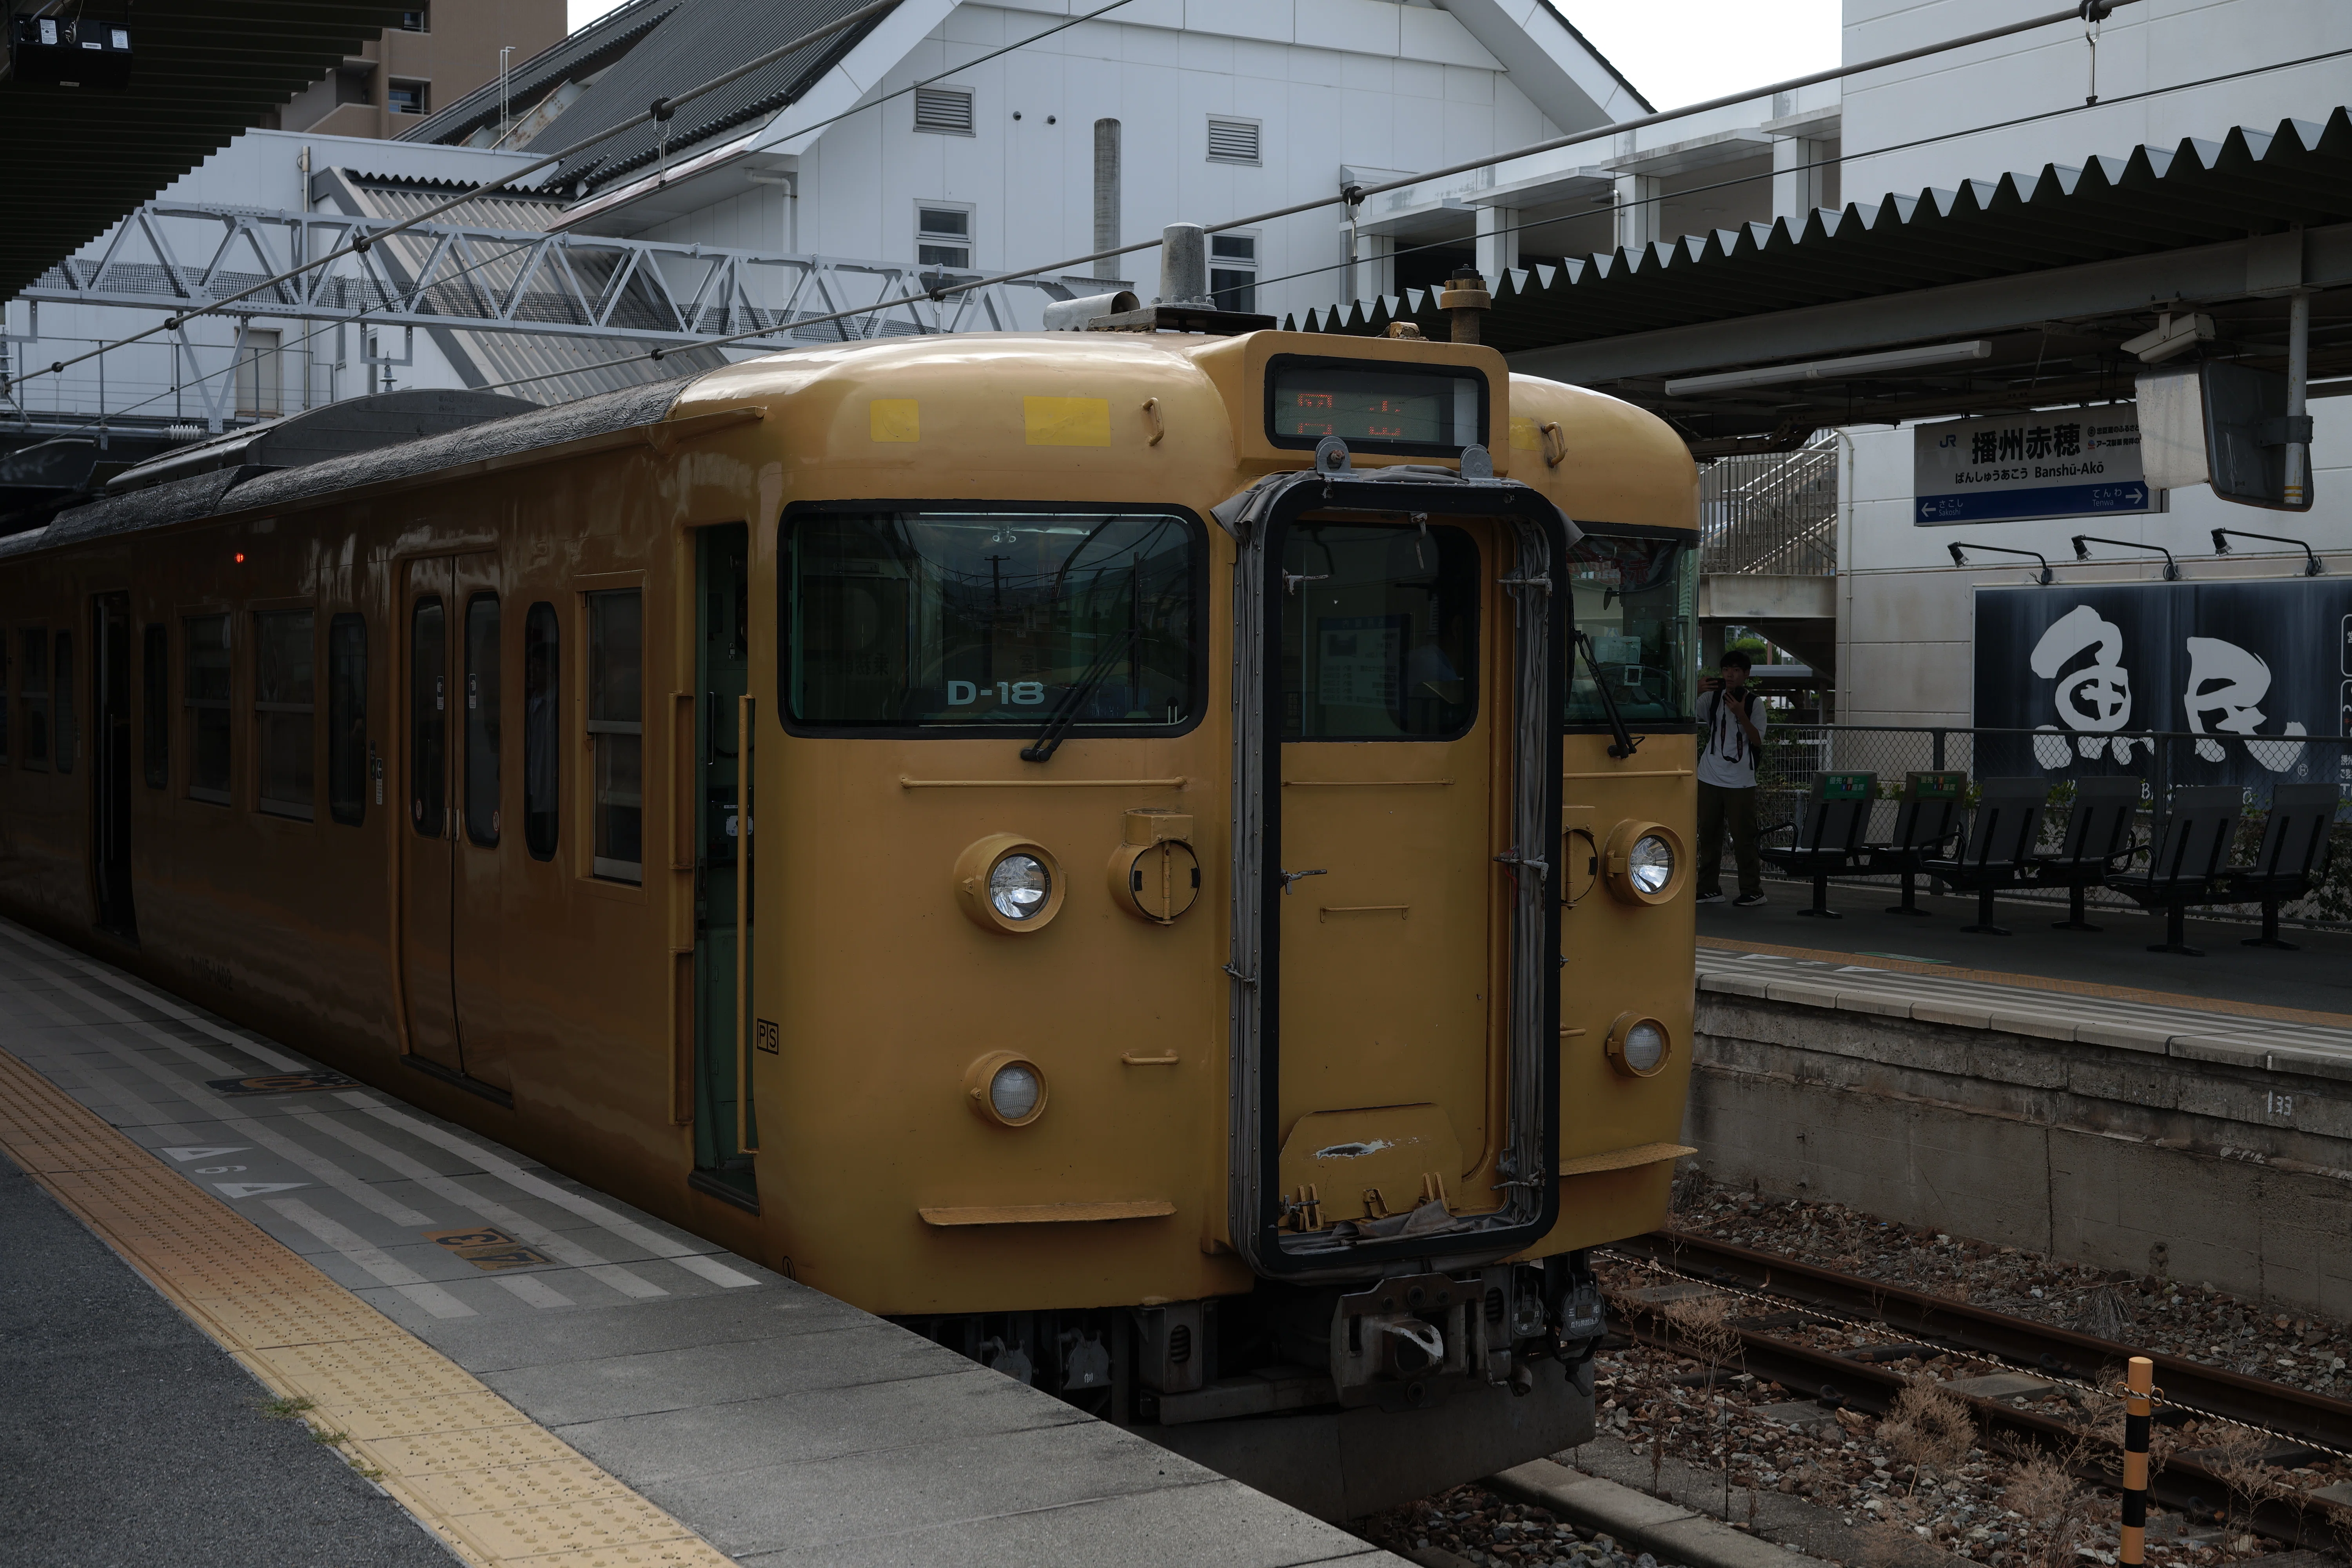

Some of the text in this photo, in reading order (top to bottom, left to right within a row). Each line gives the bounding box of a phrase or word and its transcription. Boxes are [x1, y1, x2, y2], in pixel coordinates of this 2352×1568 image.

[1940, 434, 1956, 448] JR
[1972, 423, 2081, 465] 播州赤穂
[1955, 461, 2104, 484] ばんしゅうあこう Banshū-Akō
[2092, 488, 2122, 498] てんわ
[1939, 499, 1963, 509] さこし
[2092, 499, 2114, 507] Tenwa
[1938, 508, 1961, 517] Sakoshi
[947, 680, 1045, 705] D-18
